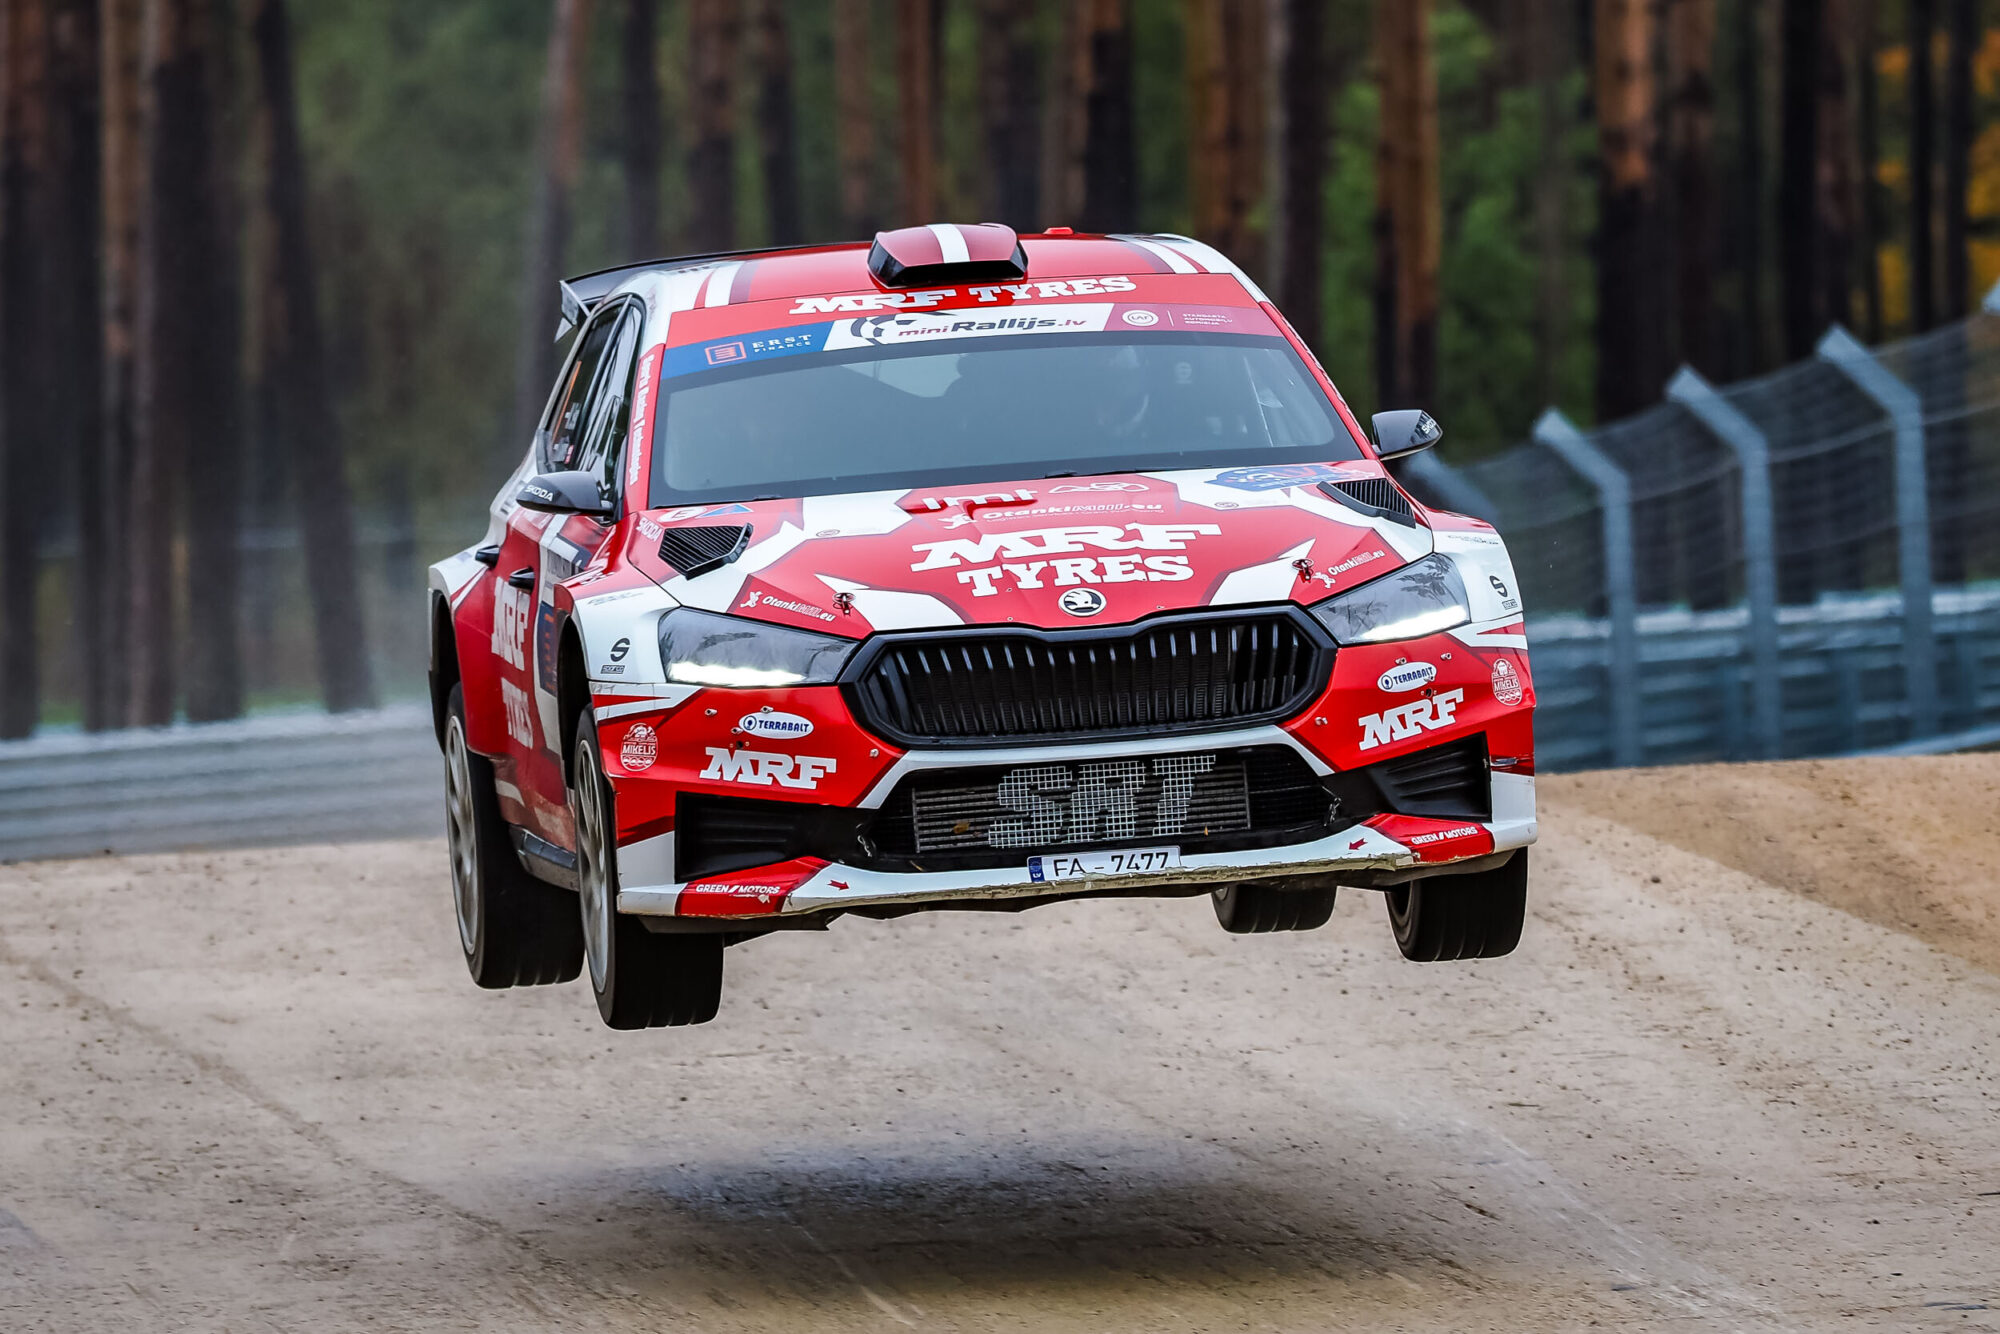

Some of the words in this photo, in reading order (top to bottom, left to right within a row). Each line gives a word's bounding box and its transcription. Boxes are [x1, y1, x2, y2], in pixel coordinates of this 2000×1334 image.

[789, 289, 957, 315] MRF
[968, 276, 1137, 302] TYRES
[752, 334, 812, 348] ERST
[898, 317, 1087, 336] miniRallijs.lv
[910, 522, 1222, 572] MRF
[956, 554, 1195, 597] TYRES
[758, 719, 810, 733] TERRABALT
[1358, 687, 1464, 751] MRF
[699, 746, 837, 790] MRF
[1411, 833, 1439, 845] GREEN
[1444, 826, 1478, 838] MOTORS
[696, 884, 730, 893] GREEN
[738, 885, 780, 894] MOTORS
